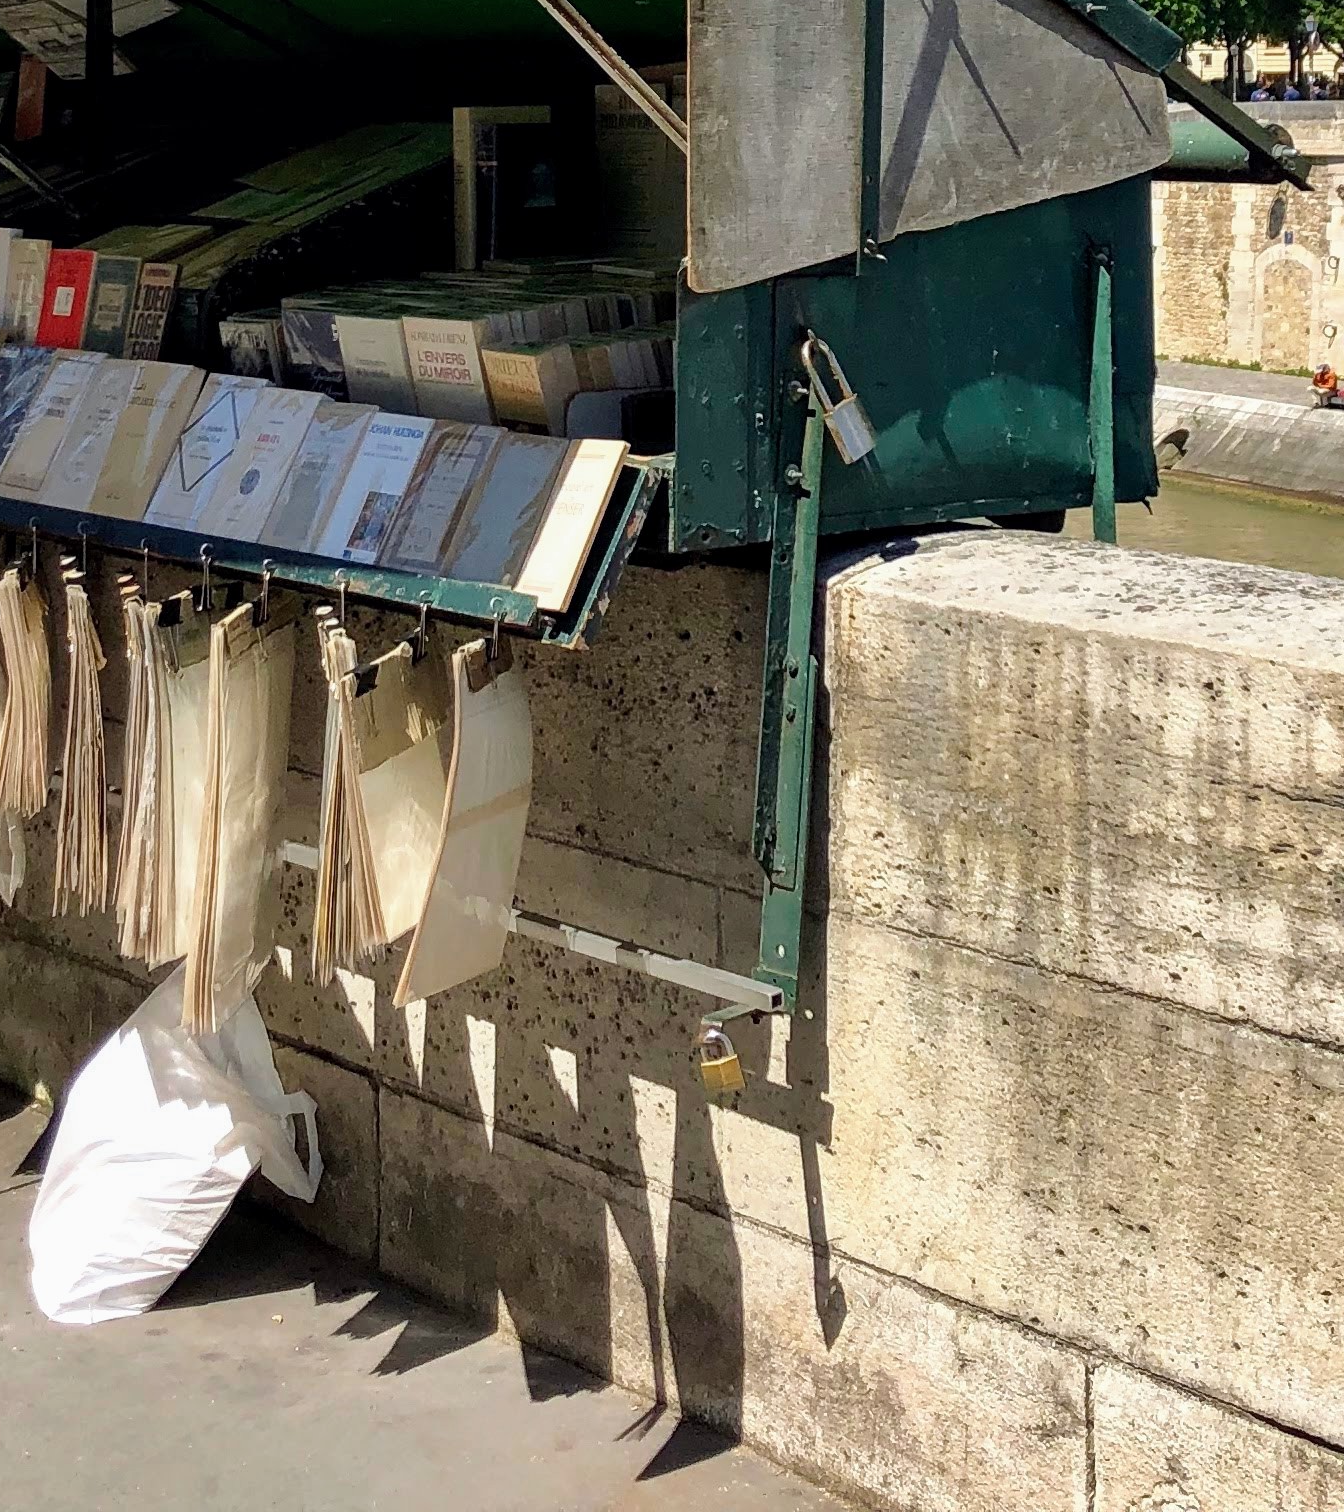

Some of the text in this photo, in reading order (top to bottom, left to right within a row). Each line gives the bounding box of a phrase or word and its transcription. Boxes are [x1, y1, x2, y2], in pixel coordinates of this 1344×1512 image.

[417, 350, 466, 366] L'ENVERS
[419, 366, 471, 381] DU MIROIR
